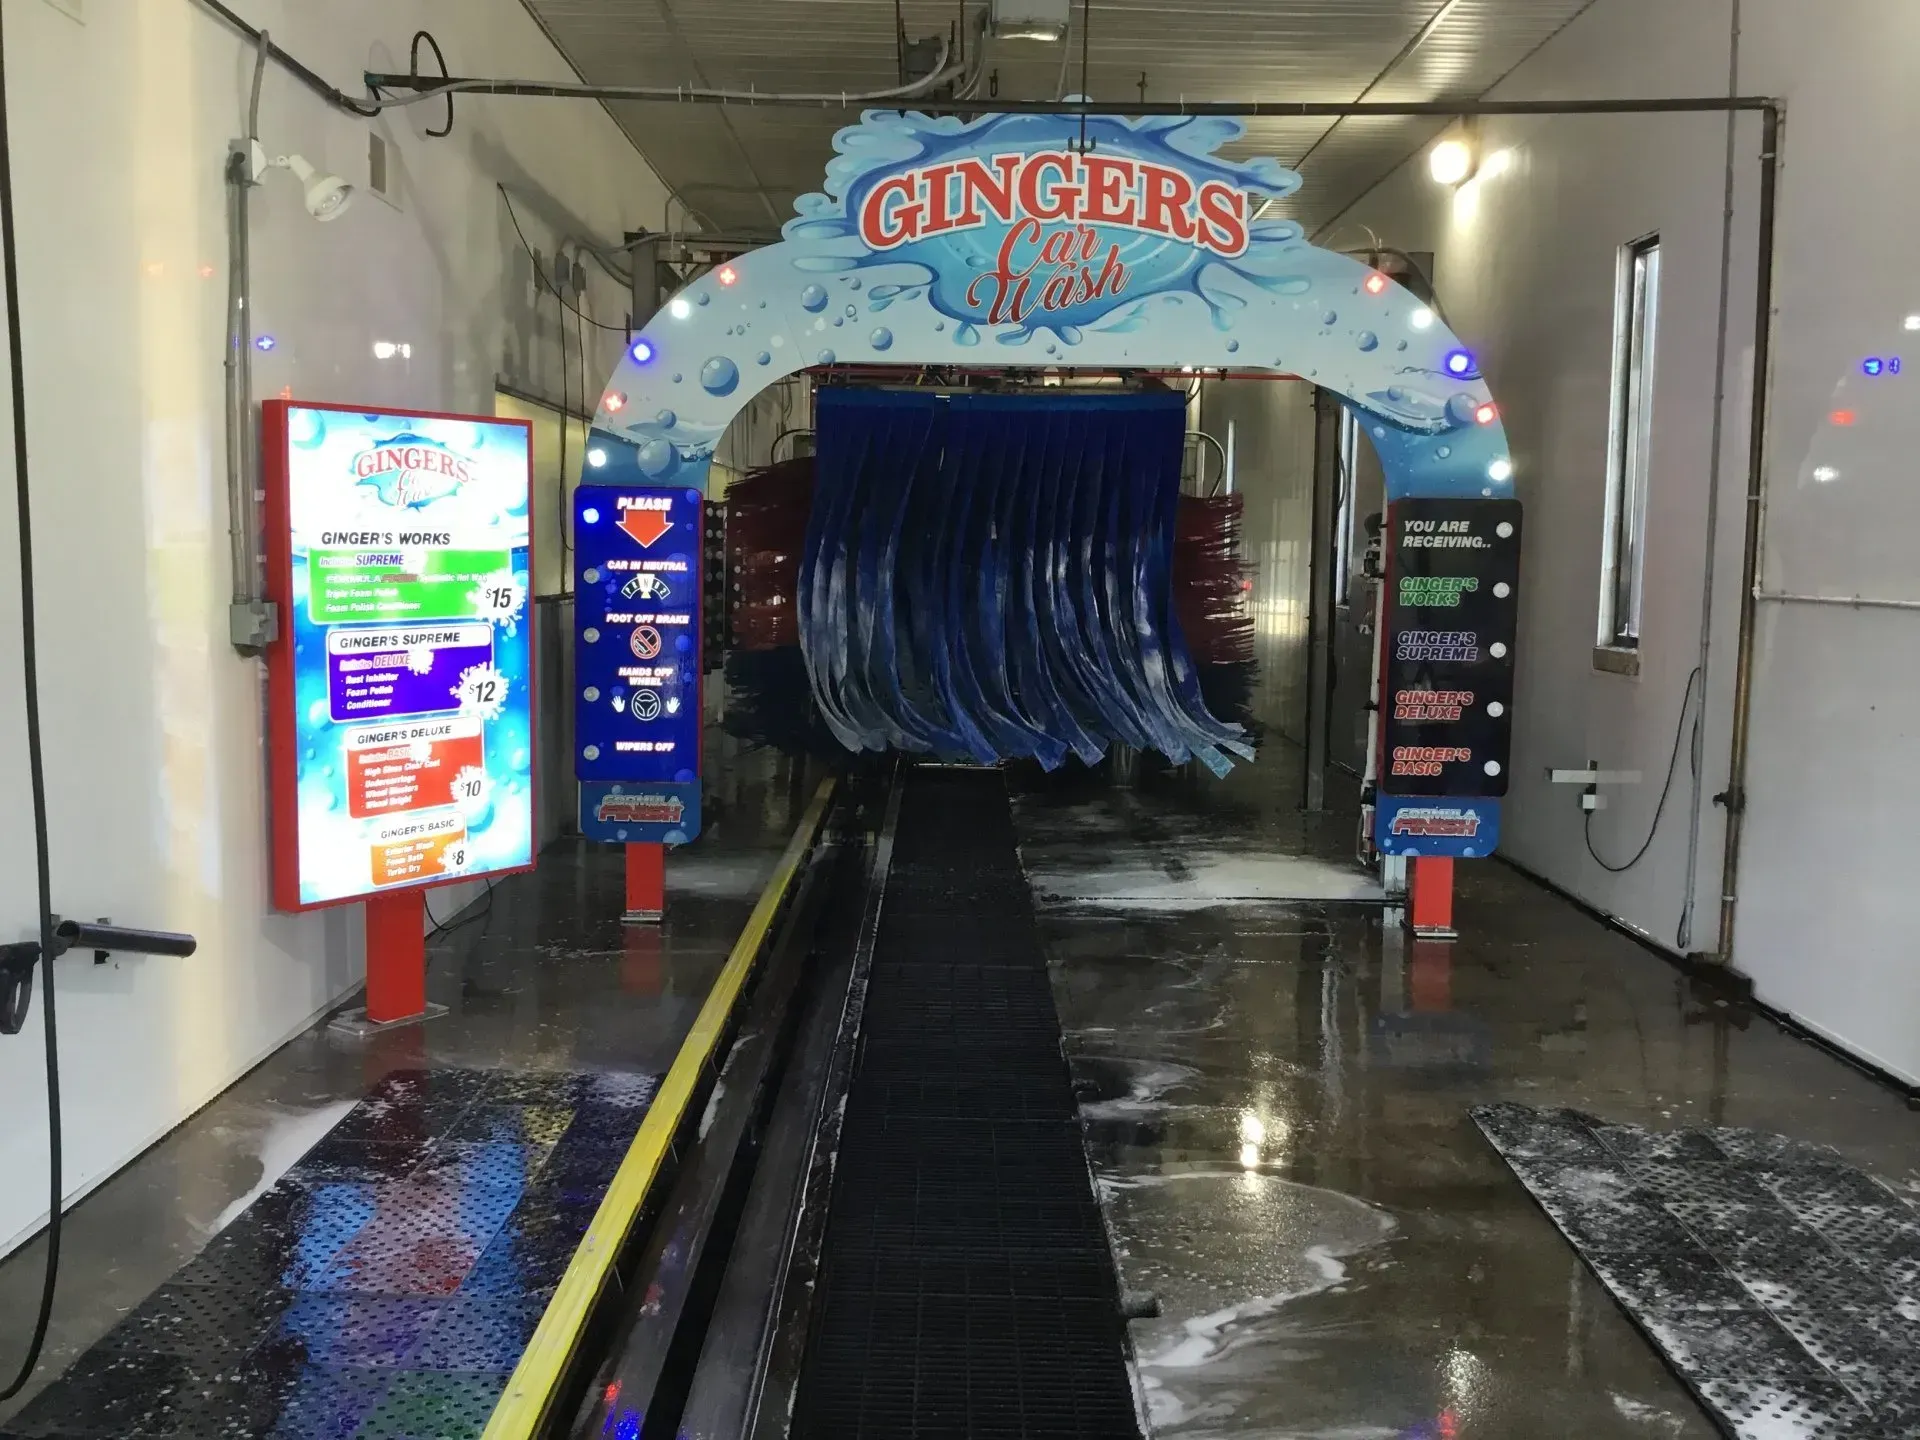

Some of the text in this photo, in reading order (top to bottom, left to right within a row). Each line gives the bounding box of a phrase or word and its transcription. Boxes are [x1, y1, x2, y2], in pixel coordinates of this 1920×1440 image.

[861, 151, 1247, 256] GINGERS
[998, 217, 1101, 279] Car
[967, 245, 1131, 326] Wash
[357, 447, 469, 483] GINGERS
[617, 497, 672, 511] PLEASE
[1404, 520, 1470, 533] YOU ARE
[321, 531, 451, 545] GINGER'S WORKS
[355, 554, 405, 566] SUPREME
[607, 560, 688, 571] CAR IN NEUTRAL
[1399, 577, 1479, 592] GINGER'S
[485, 587, 512, 608] $15
[1399, 592, 1460, 606] WORKS
[606, 613, 690, 624] FOOT OFF BRAKE
[339, 632, 460, 649] GINGER'S SUPREME
[1397, 630, 1476, 646] GINGER'S
[373, 654, 411, 668] DELUXE
[1396, 646, 1478, 661] SUPREME
[618, 667, 674, 677] HANDS OFF
[628, 677, 662, 686] WHEEL
[468, 681, 496, 703] $12
[1395, 690, 1474, 706] GINGER'S
[1394, 705, 1462, 721] DELUXE
[357, 725, 452, 745] GINGER'S DELUXE
[615, 741, 675, 752] WIPERS OFF
[1393, 746, 1471, 762] GINGER'S
[1392, 762, 1442, 776] BASIC
[460, 780, 481, 797] $10
[1396, 807, 1477, 819] FORMULA
[381, 819, 455, 839] GINGER'S BASIC
[452, 850, 465, 866] $8
[408, 864, 421, 873] Dry
